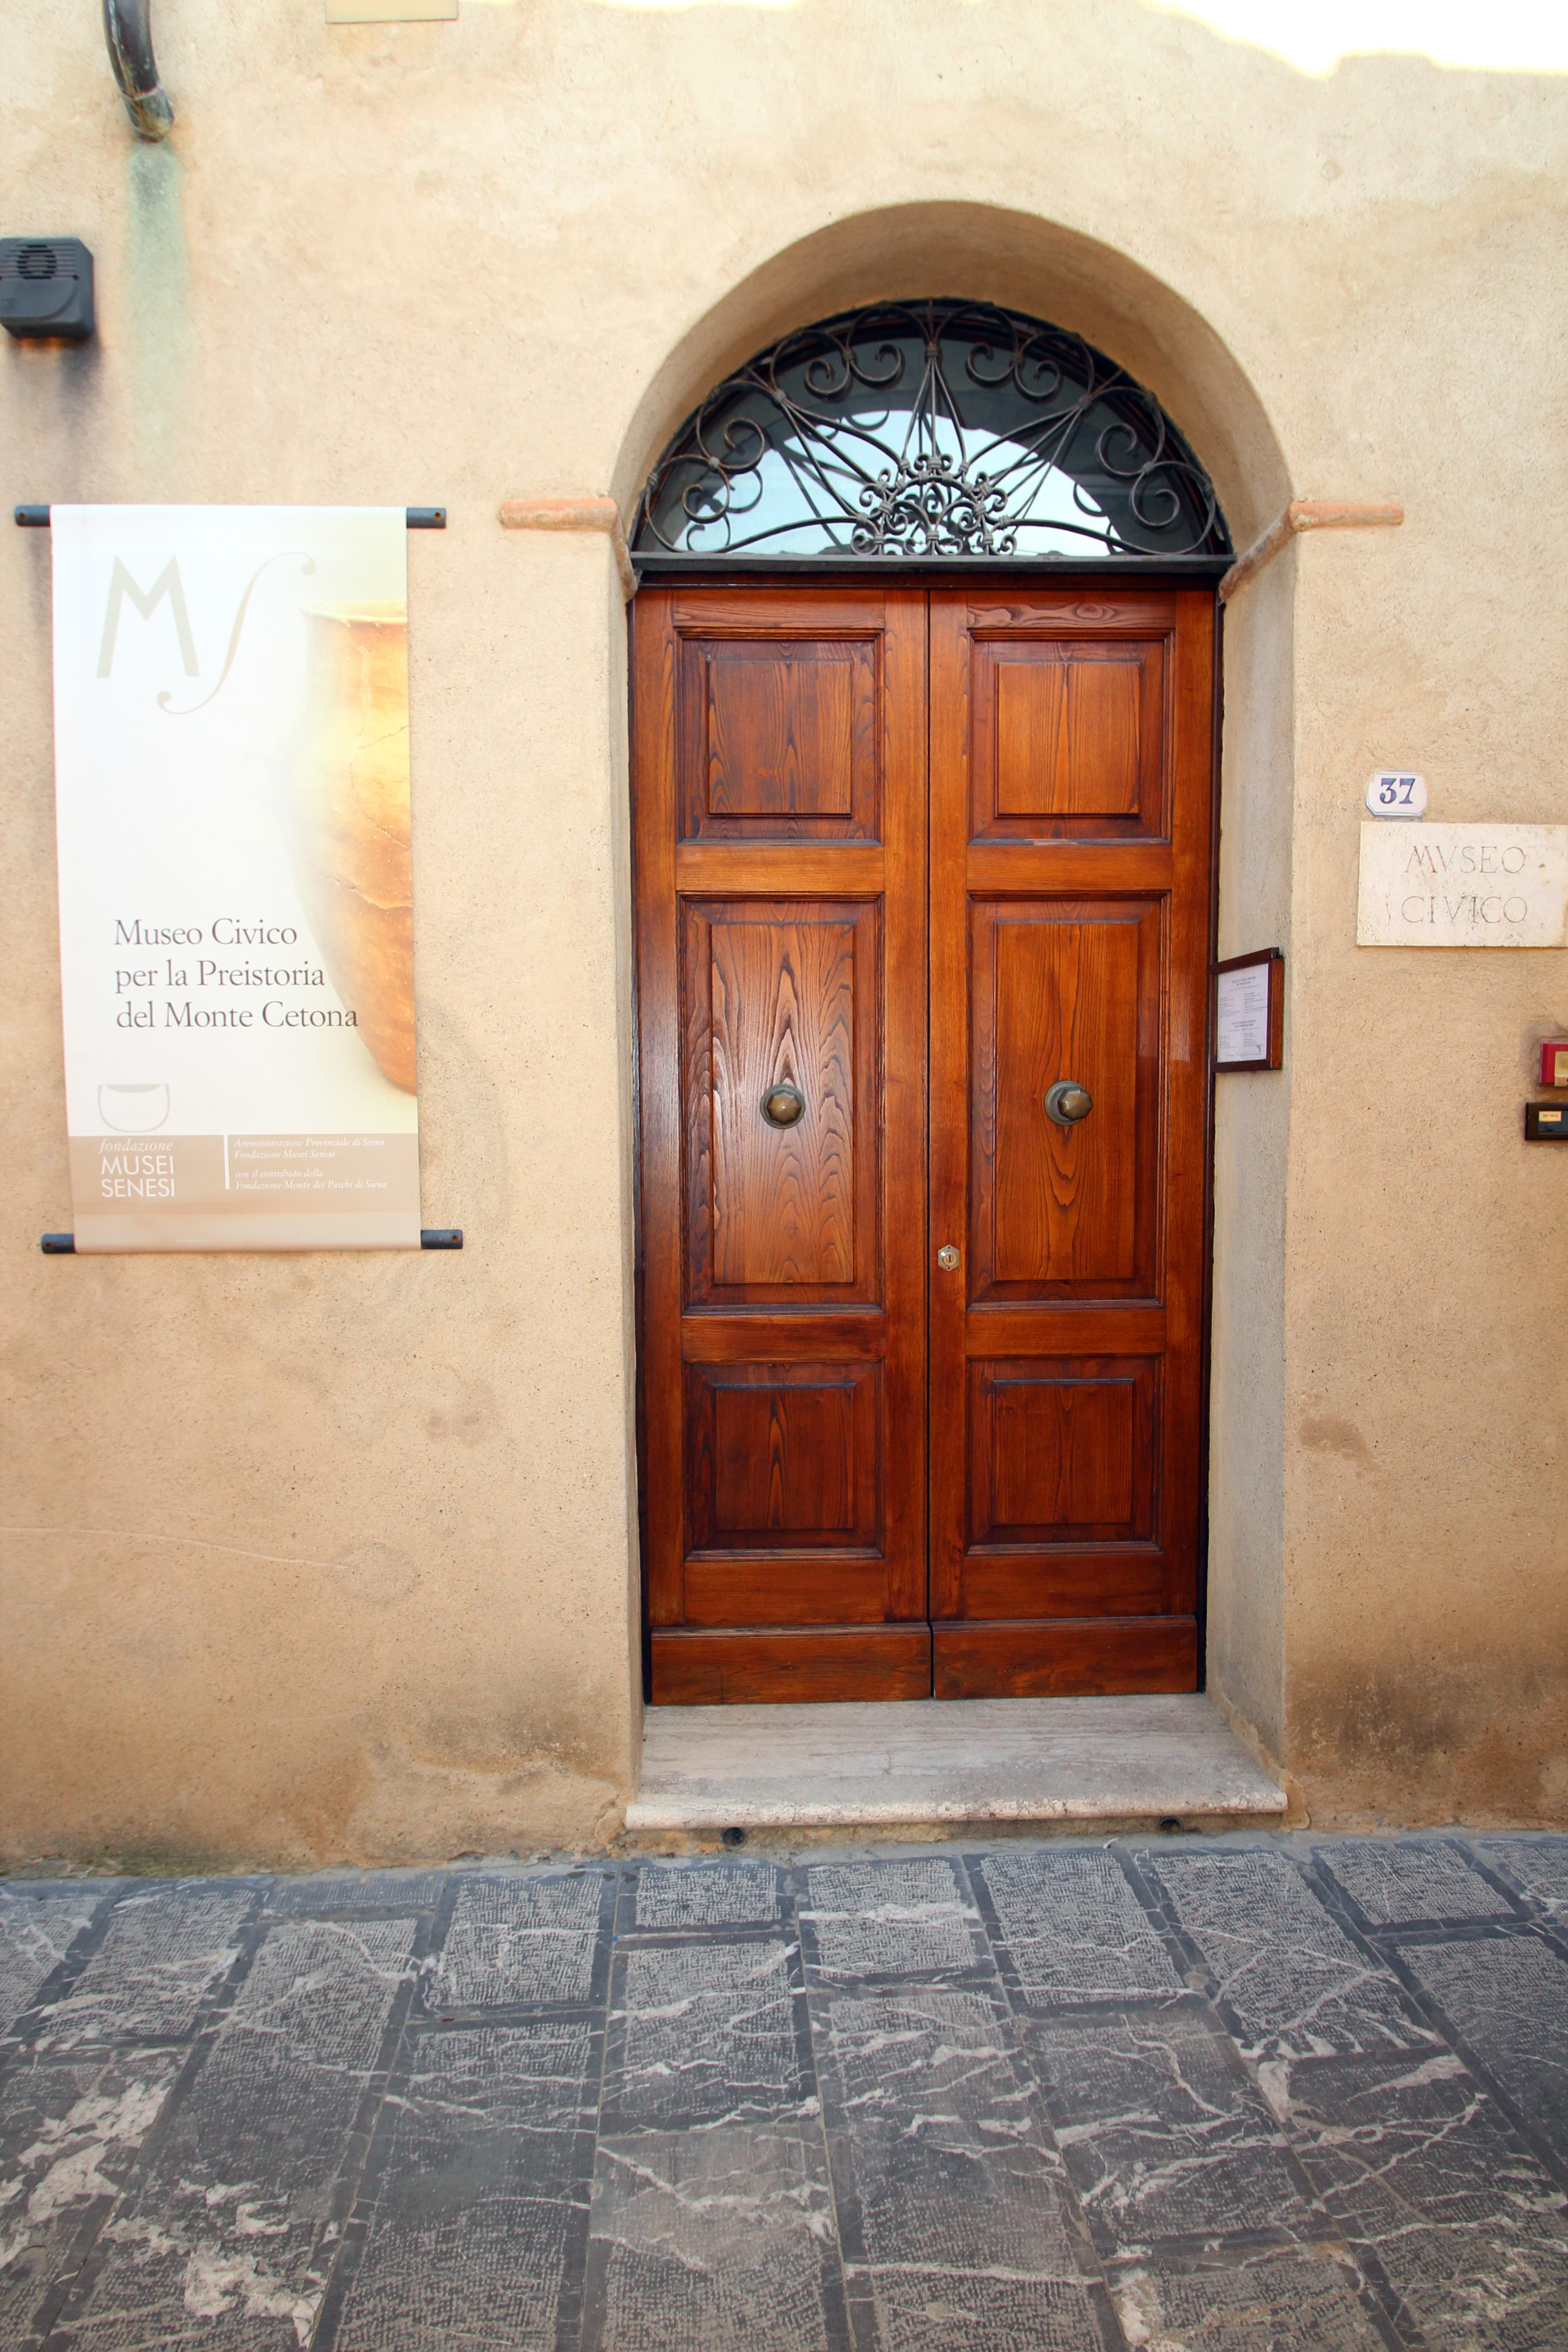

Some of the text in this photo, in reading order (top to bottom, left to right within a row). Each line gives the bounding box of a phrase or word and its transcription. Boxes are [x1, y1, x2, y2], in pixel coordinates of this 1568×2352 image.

[1379, 777, 1416, 804] 37
[1401, 896, 1528, 925] CIVICO
[113, 918, 298, 945] Museo Civico
[115, 959, 326, 994] per la Preistoria
[117, 1000, 359, 1028] del Monte Cetona
[98, 1138, 173, 1154] fondazione
[234, 1137, 385, 1147] Amministrazione Provinciale di Siena
[235, 1149, 336, 1158] Fondazione Musei Senesi
[101, 1155, 174, 1175] MUSEI
[252, 1169, 258, 1178] il
[260, 1169, 302, 1177] contributo
[304, 1168, 323, 1177] della
[101, 1178, 175, 1197] SENESI
[236, 1179, 387, 1190] Fondazione Monte dei Paschi di Siena
